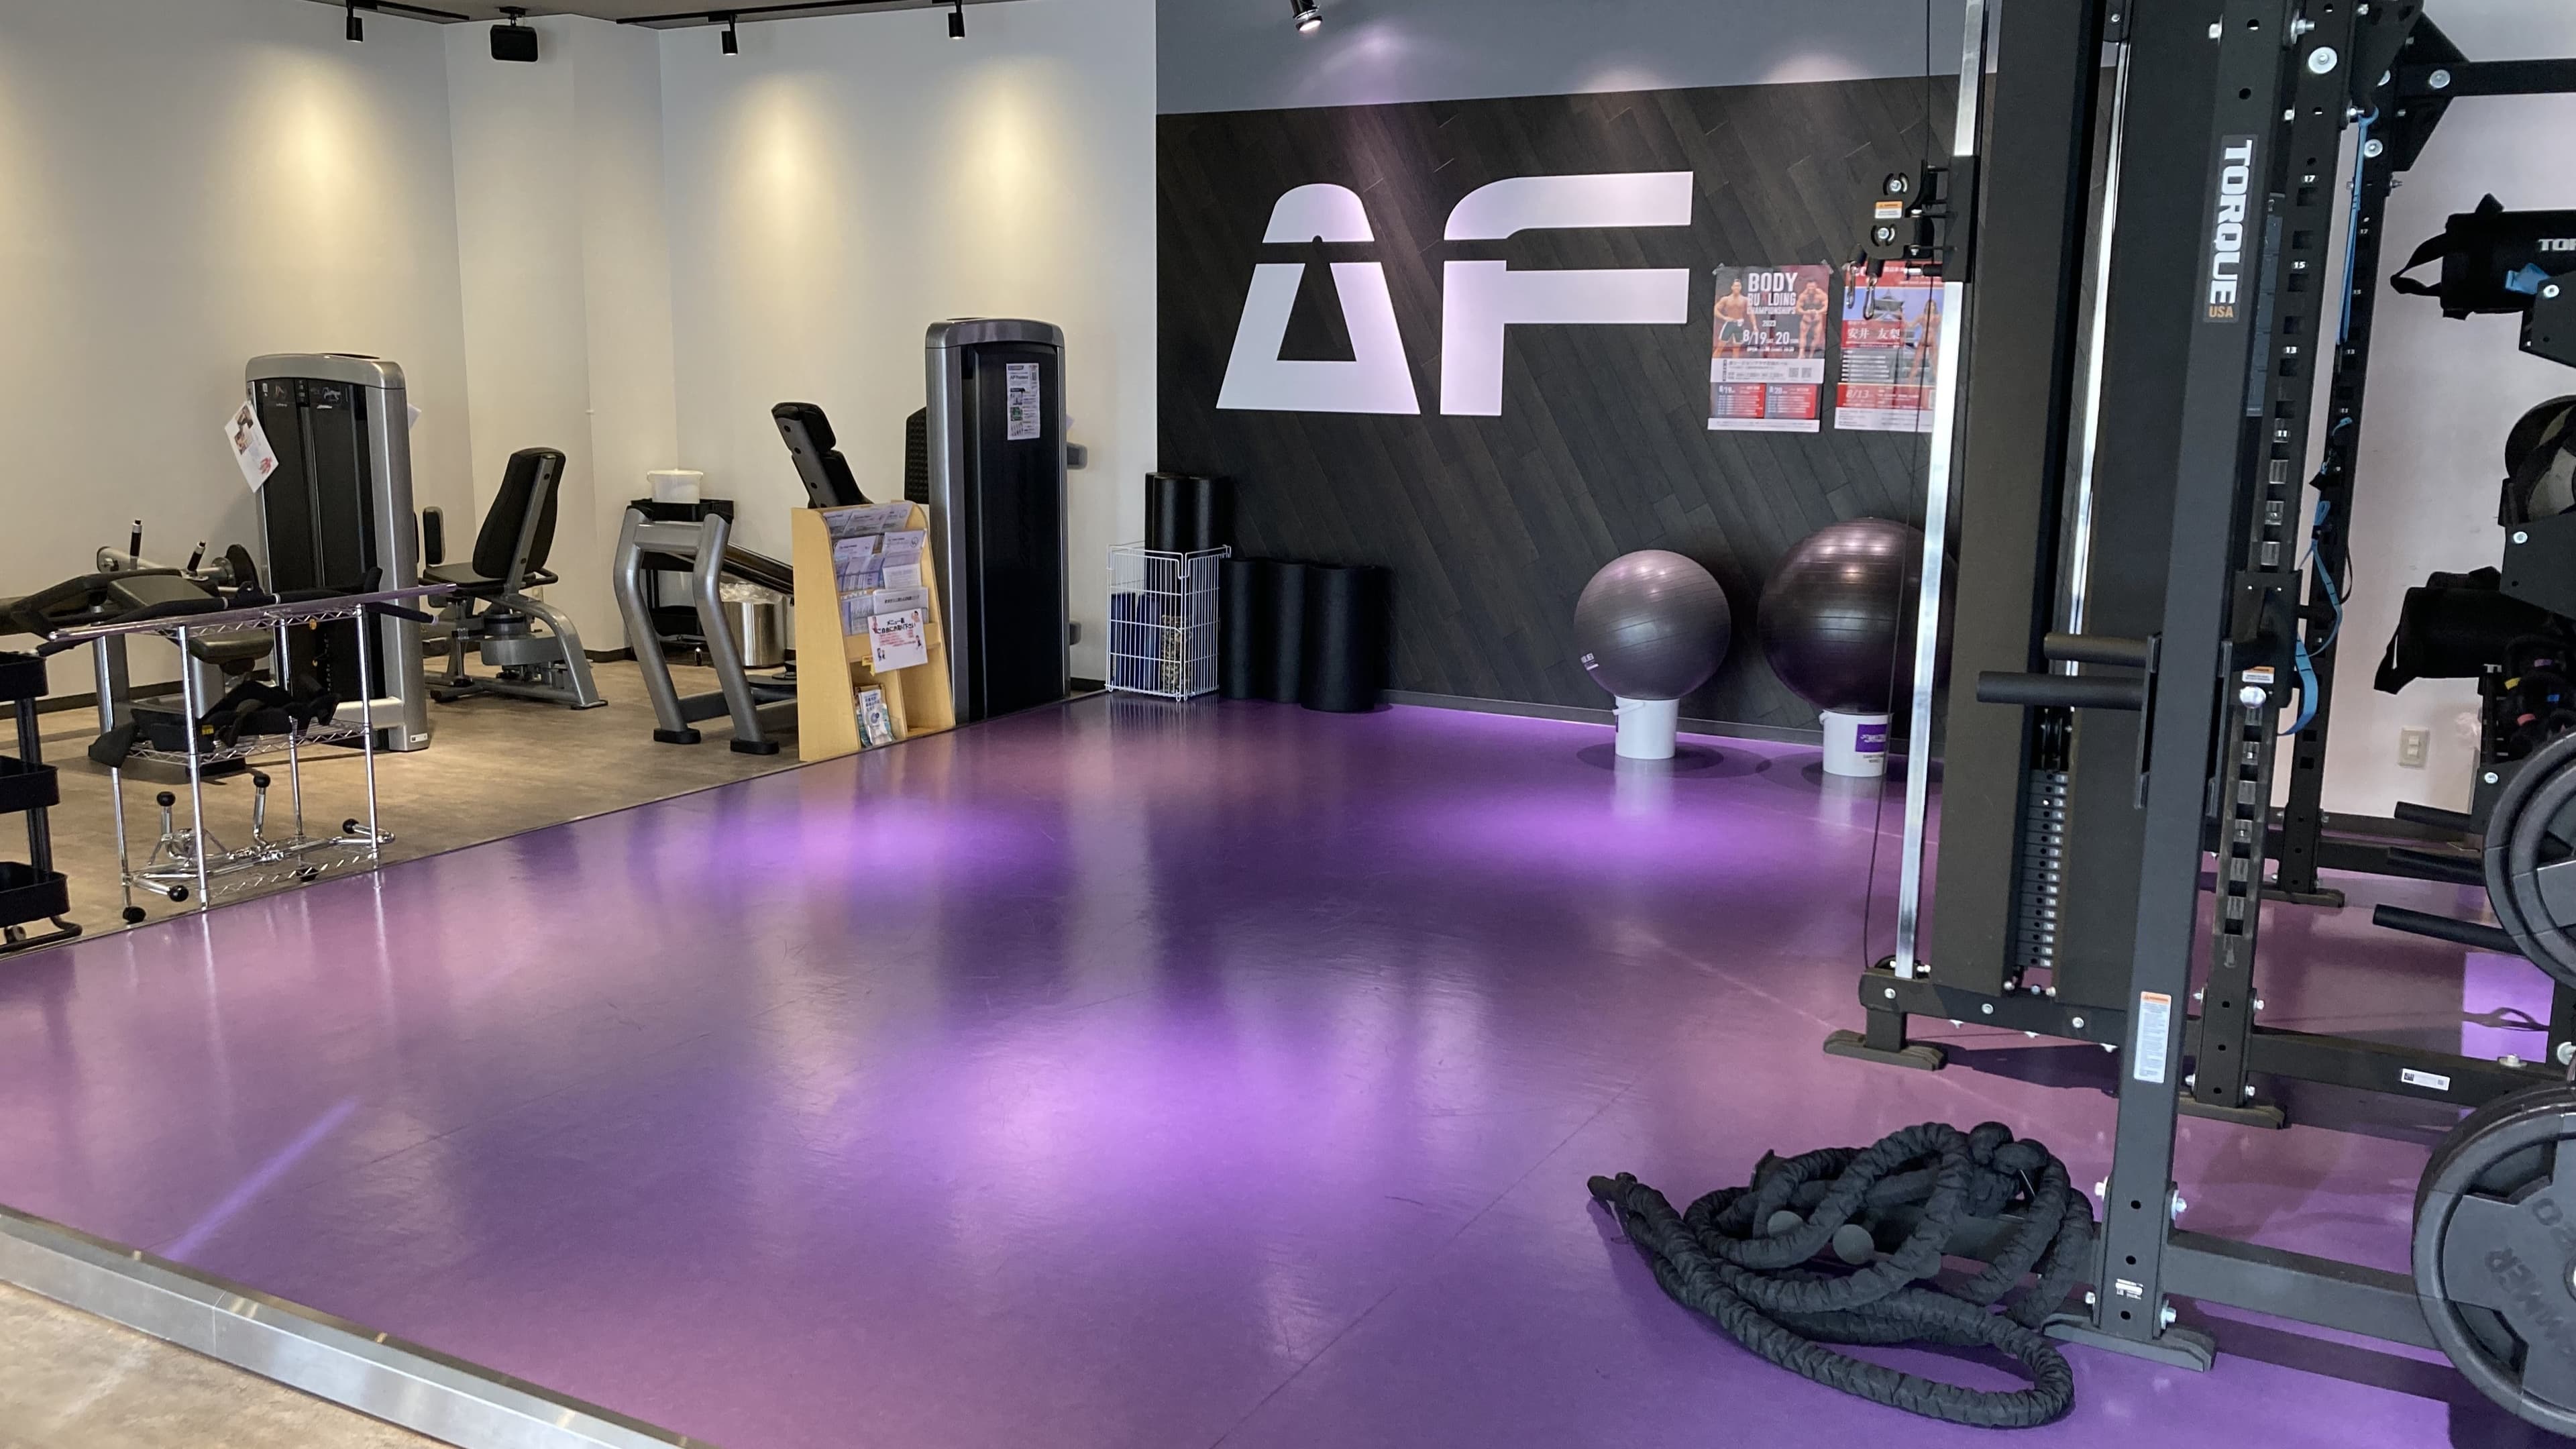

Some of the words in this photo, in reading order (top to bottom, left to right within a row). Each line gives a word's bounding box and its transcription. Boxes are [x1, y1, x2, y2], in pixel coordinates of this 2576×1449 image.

[2210, 139, 2253, 304] TORQUE
[1748, 272, 1798, 292] BODY
[1216, 171, 1693, 416] AF
[2209, 306, 2233, 318] USA
[1743, 329, 1767, 344] 8/19
[1776, 332, 1790, 344] 20
[1846, 390, 1869, 398] 8/13
